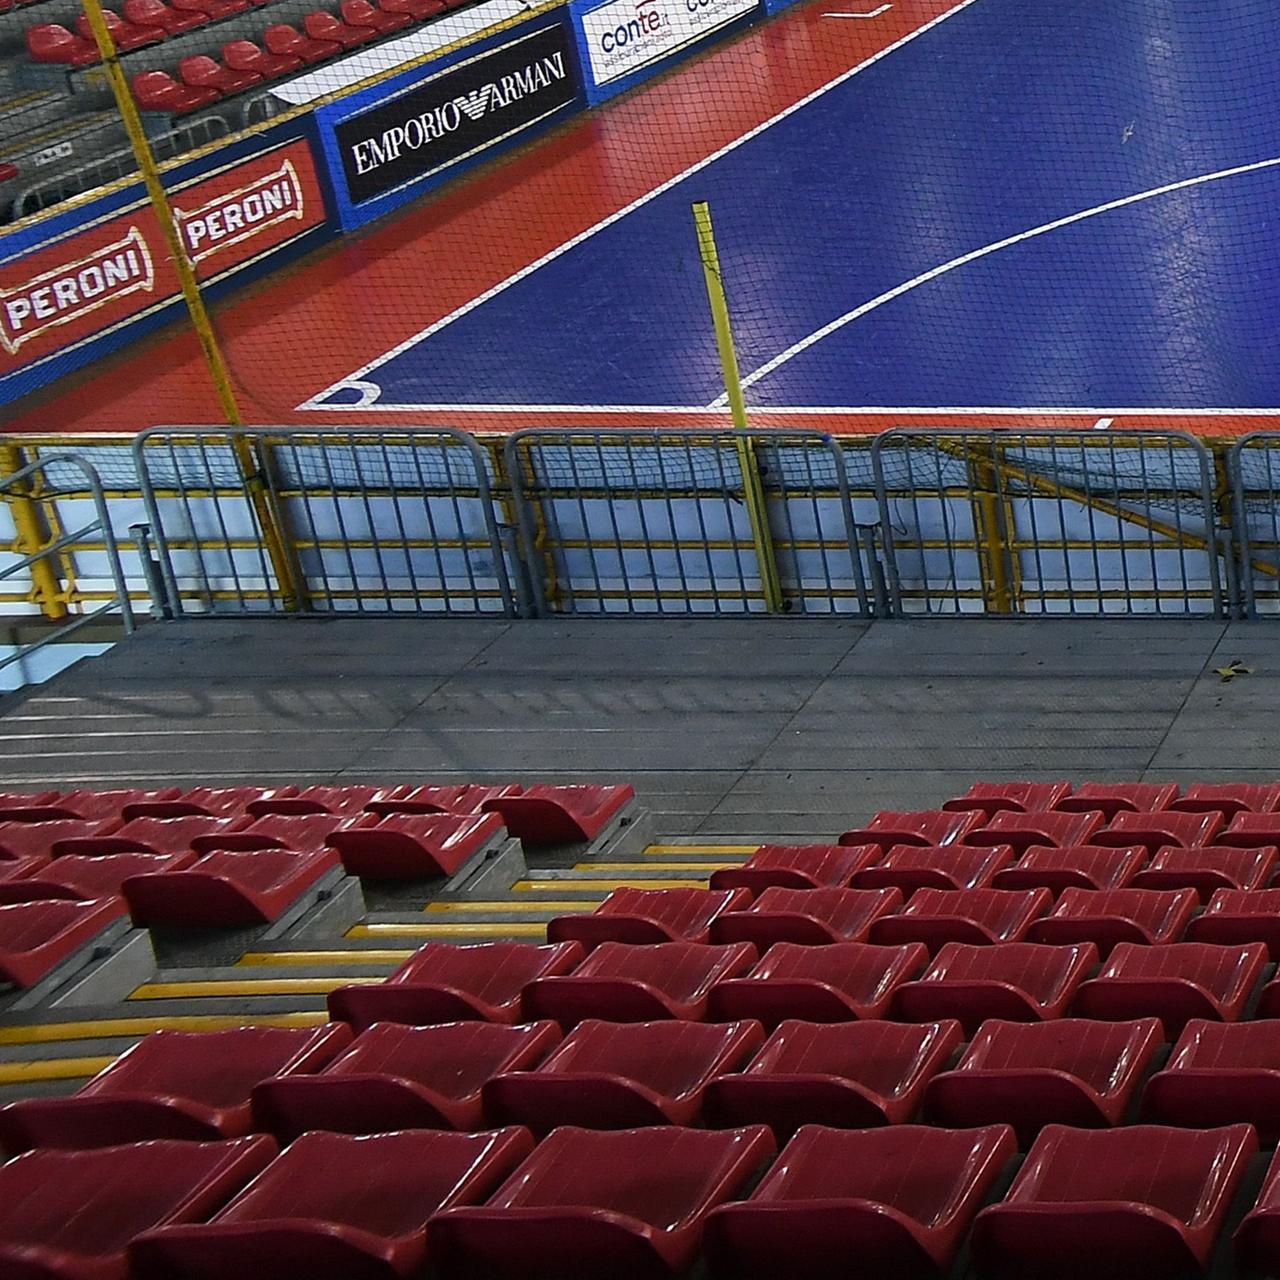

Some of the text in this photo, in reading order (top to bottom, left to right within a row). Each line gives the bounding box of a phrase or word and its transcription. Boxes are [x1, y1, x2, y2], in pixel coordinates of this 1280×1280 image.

[351, 51, 566, 175] EMPORIO ARMANI
[186, 180, 293, 249] PERONI
[4, 249, 140, 329] PERONI
